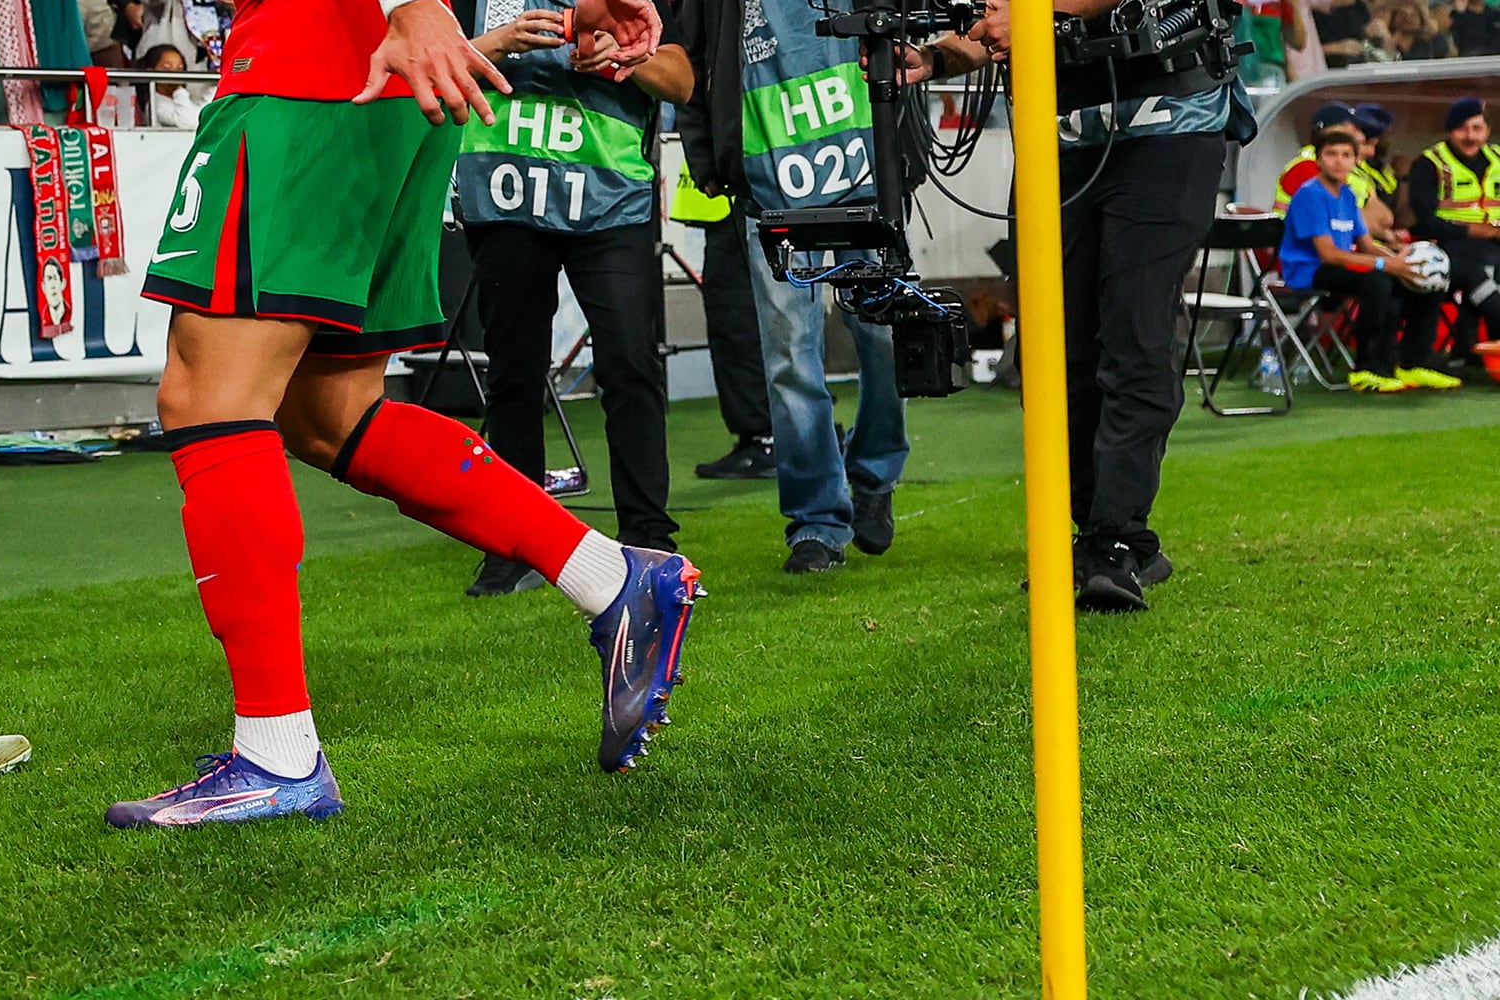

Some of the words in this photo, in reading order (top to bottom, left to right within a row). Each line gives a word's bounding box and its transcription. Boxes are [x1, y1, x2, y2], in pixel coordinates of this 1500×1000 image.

[507, 99, 584, 153] HB
[780, 75, 855, 137] HB
[170, 151, 212, 233] 5
[489, 163, 586, 222] 011
[777, 136, 875, 199] 022
